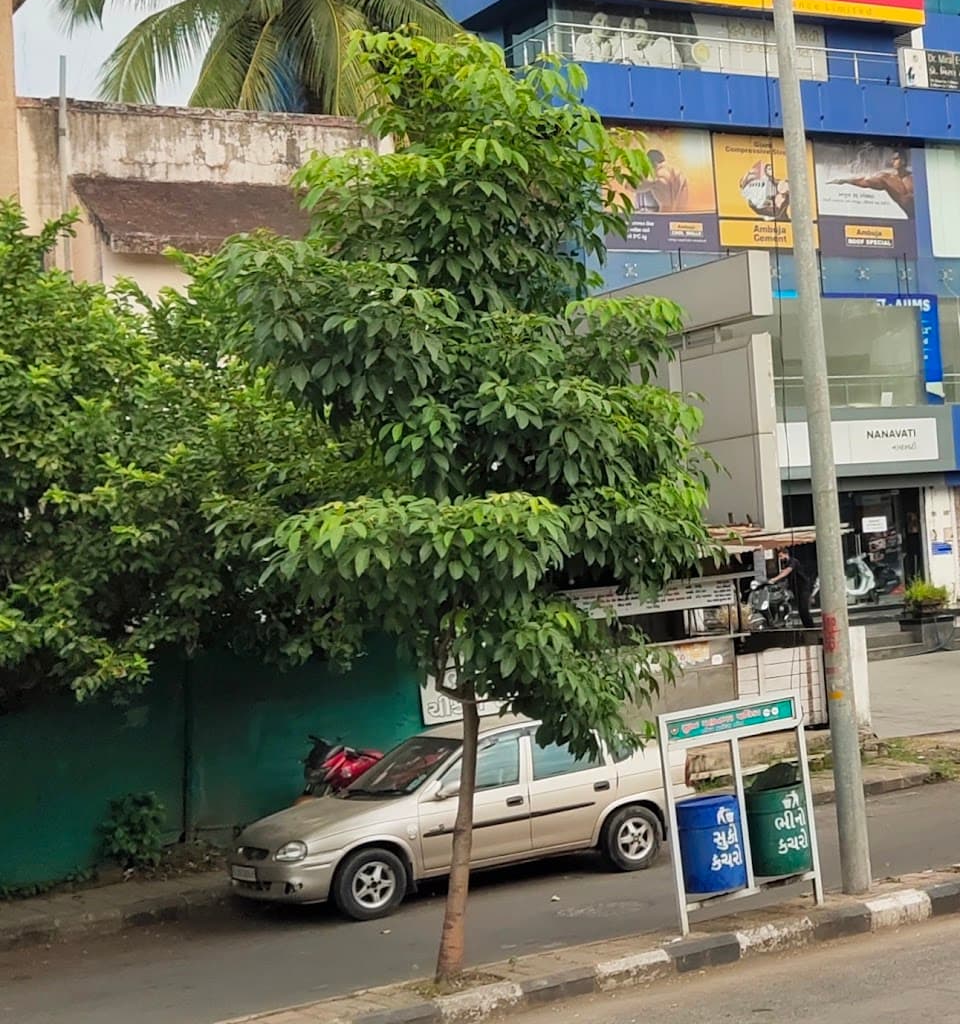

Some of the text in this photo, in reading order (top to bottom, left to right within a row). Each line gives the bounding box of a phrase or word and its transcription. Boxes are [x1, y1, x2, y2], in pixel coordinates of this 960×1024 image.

[866, 428, 917, 440] NANAVATI
[778, 829, 808, 855] કચરો
[711, 845, 743, 871] કચરો
